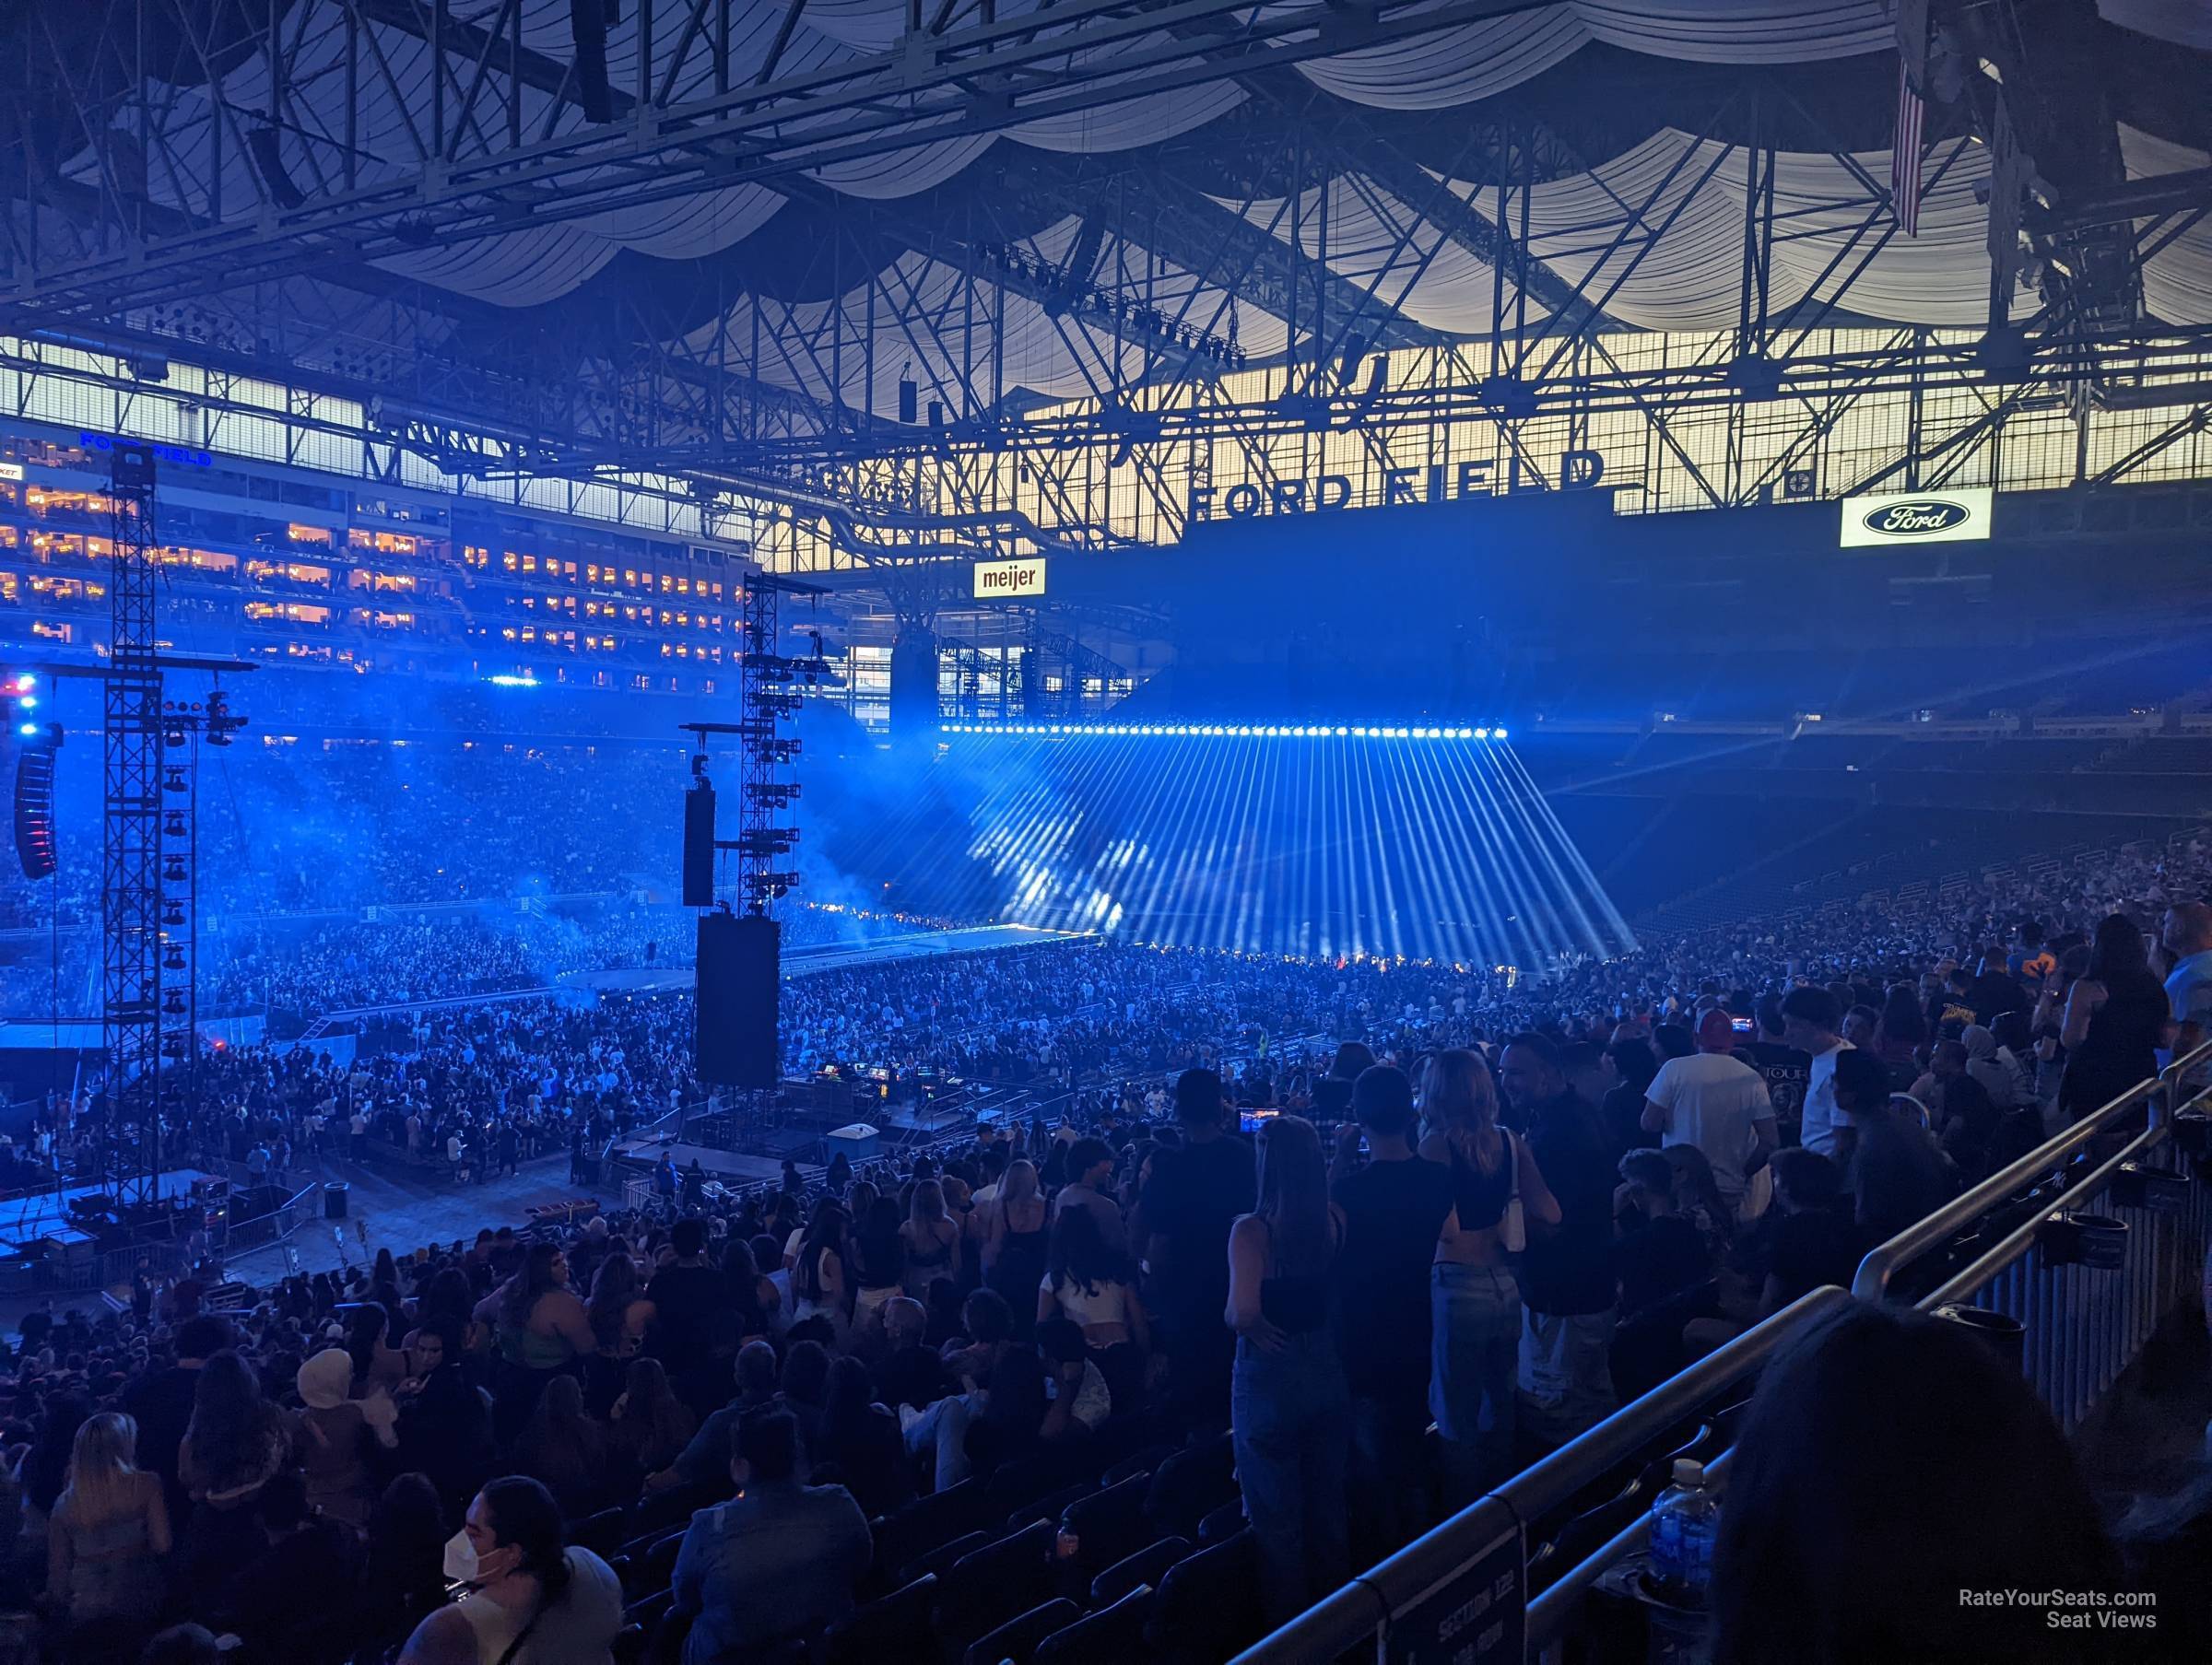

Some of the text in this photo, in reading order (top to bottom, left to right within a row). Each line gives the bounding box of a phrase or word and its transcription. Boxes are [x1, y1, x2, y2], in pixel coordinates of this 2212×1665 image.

[1187, 450, 1605, 522] FORD FIELD
[1883, 505, 1948, 530] Ford
[983, 565, 1036, 592] meijer
